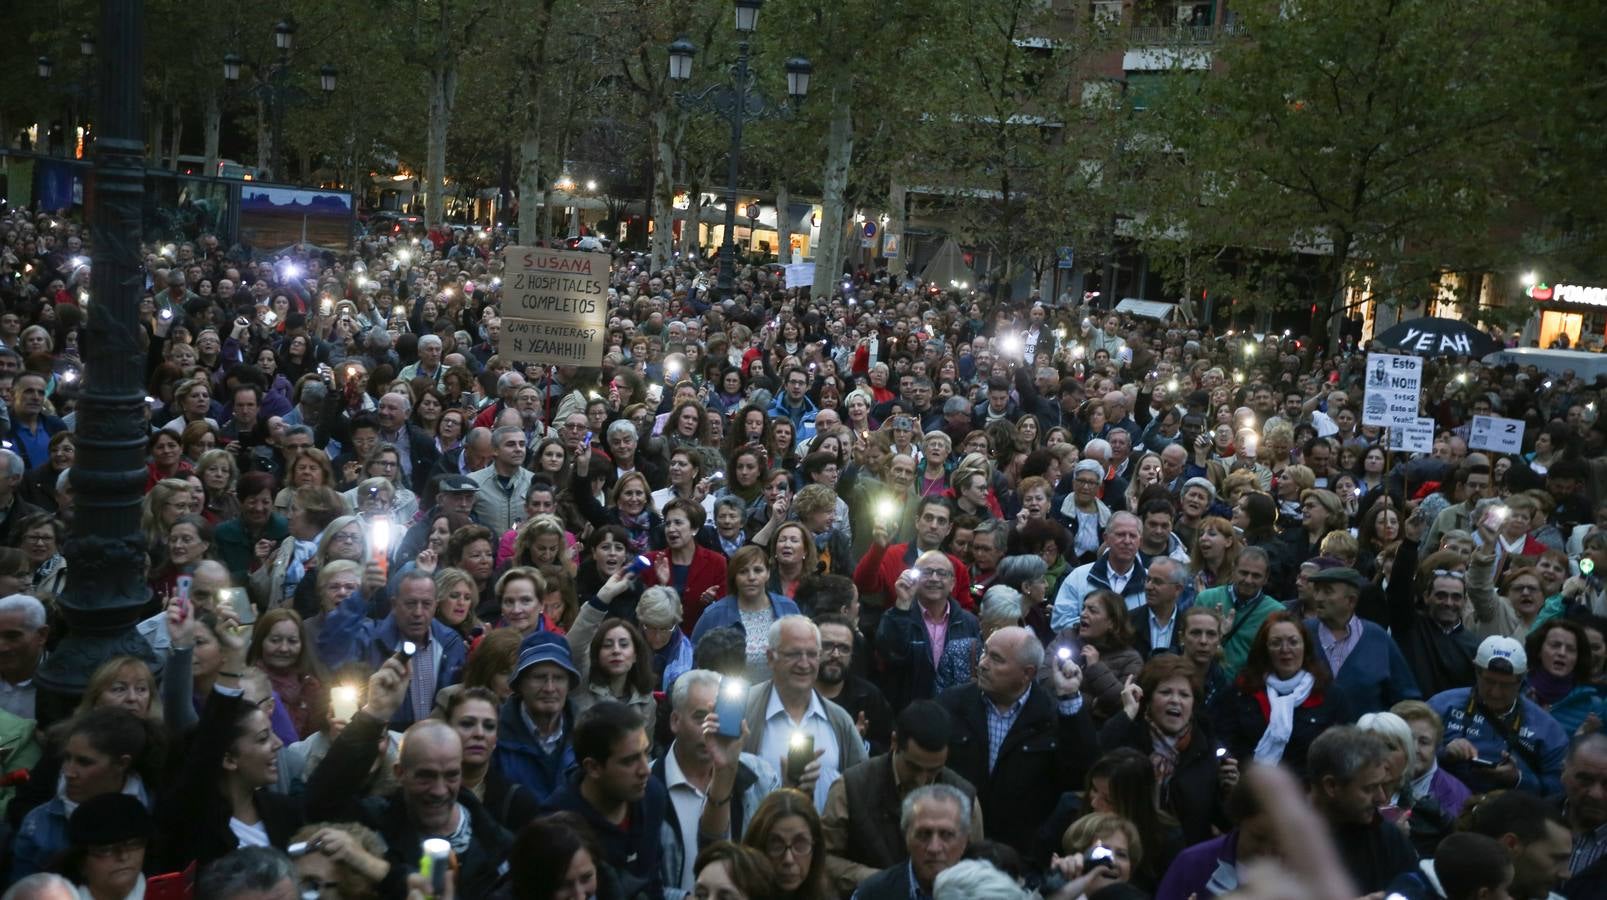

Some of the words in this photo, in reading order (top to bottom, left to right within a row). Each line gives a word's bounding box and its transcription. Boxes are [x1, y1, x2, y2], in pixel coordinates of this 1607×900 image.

[524, 255, 592, 272] SUSANA
[514, 274, 524, 289] 2
[528, 276, 601, 295] HOSPITALES
[522, 294, 595, 313] COMPLETOS
[531, 325, 543, 333] TE
[545, 327, 597, 342] ENTERAS?
[1400, 328, 1471, 353] YEAH
[1393, 358, 1416, 369] Esto
[1392, 378, 1417, 390] NO!!!
[1391, 404, 1406, 412] Esto
[1505, 424, 1516, 433] 2
